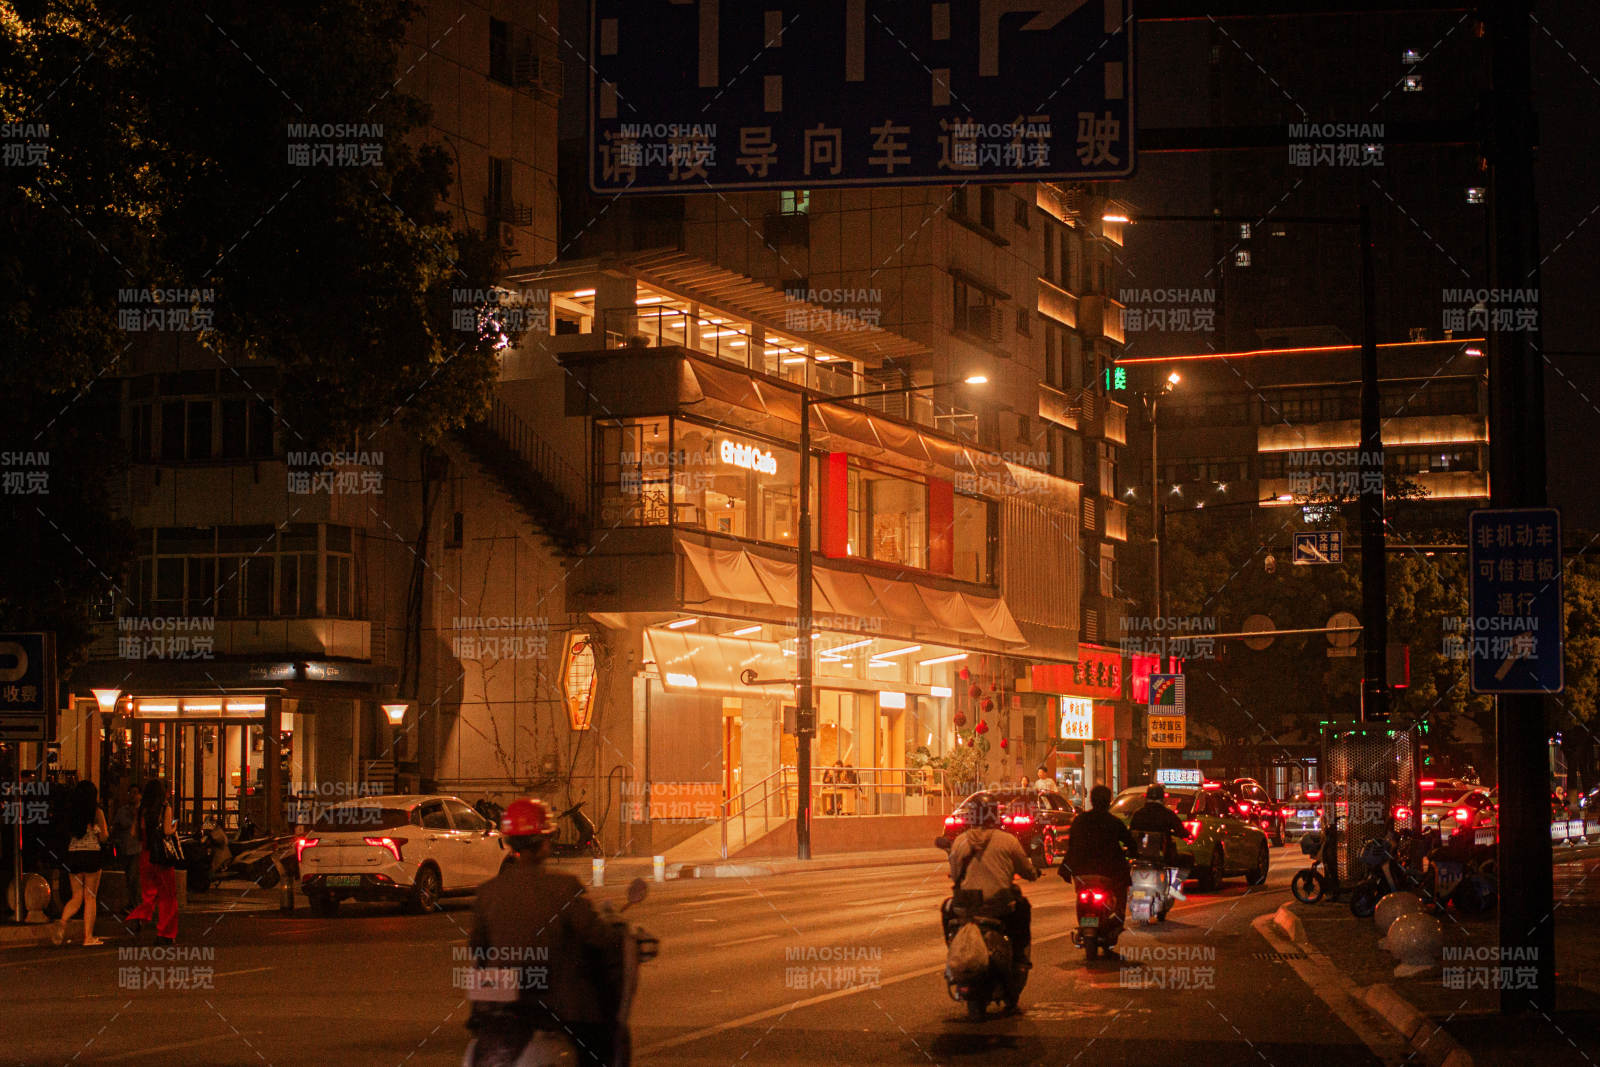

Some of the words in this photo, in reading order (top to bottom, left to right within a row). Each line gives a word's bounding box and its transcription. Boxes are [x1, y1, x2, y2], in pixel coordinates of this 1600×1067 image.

[598, 111, 1122, 184] 请按导向车道行驶
[1477, 523, 1553, 549] 非机动车
[1496, 592, 1535, 617] 通行
